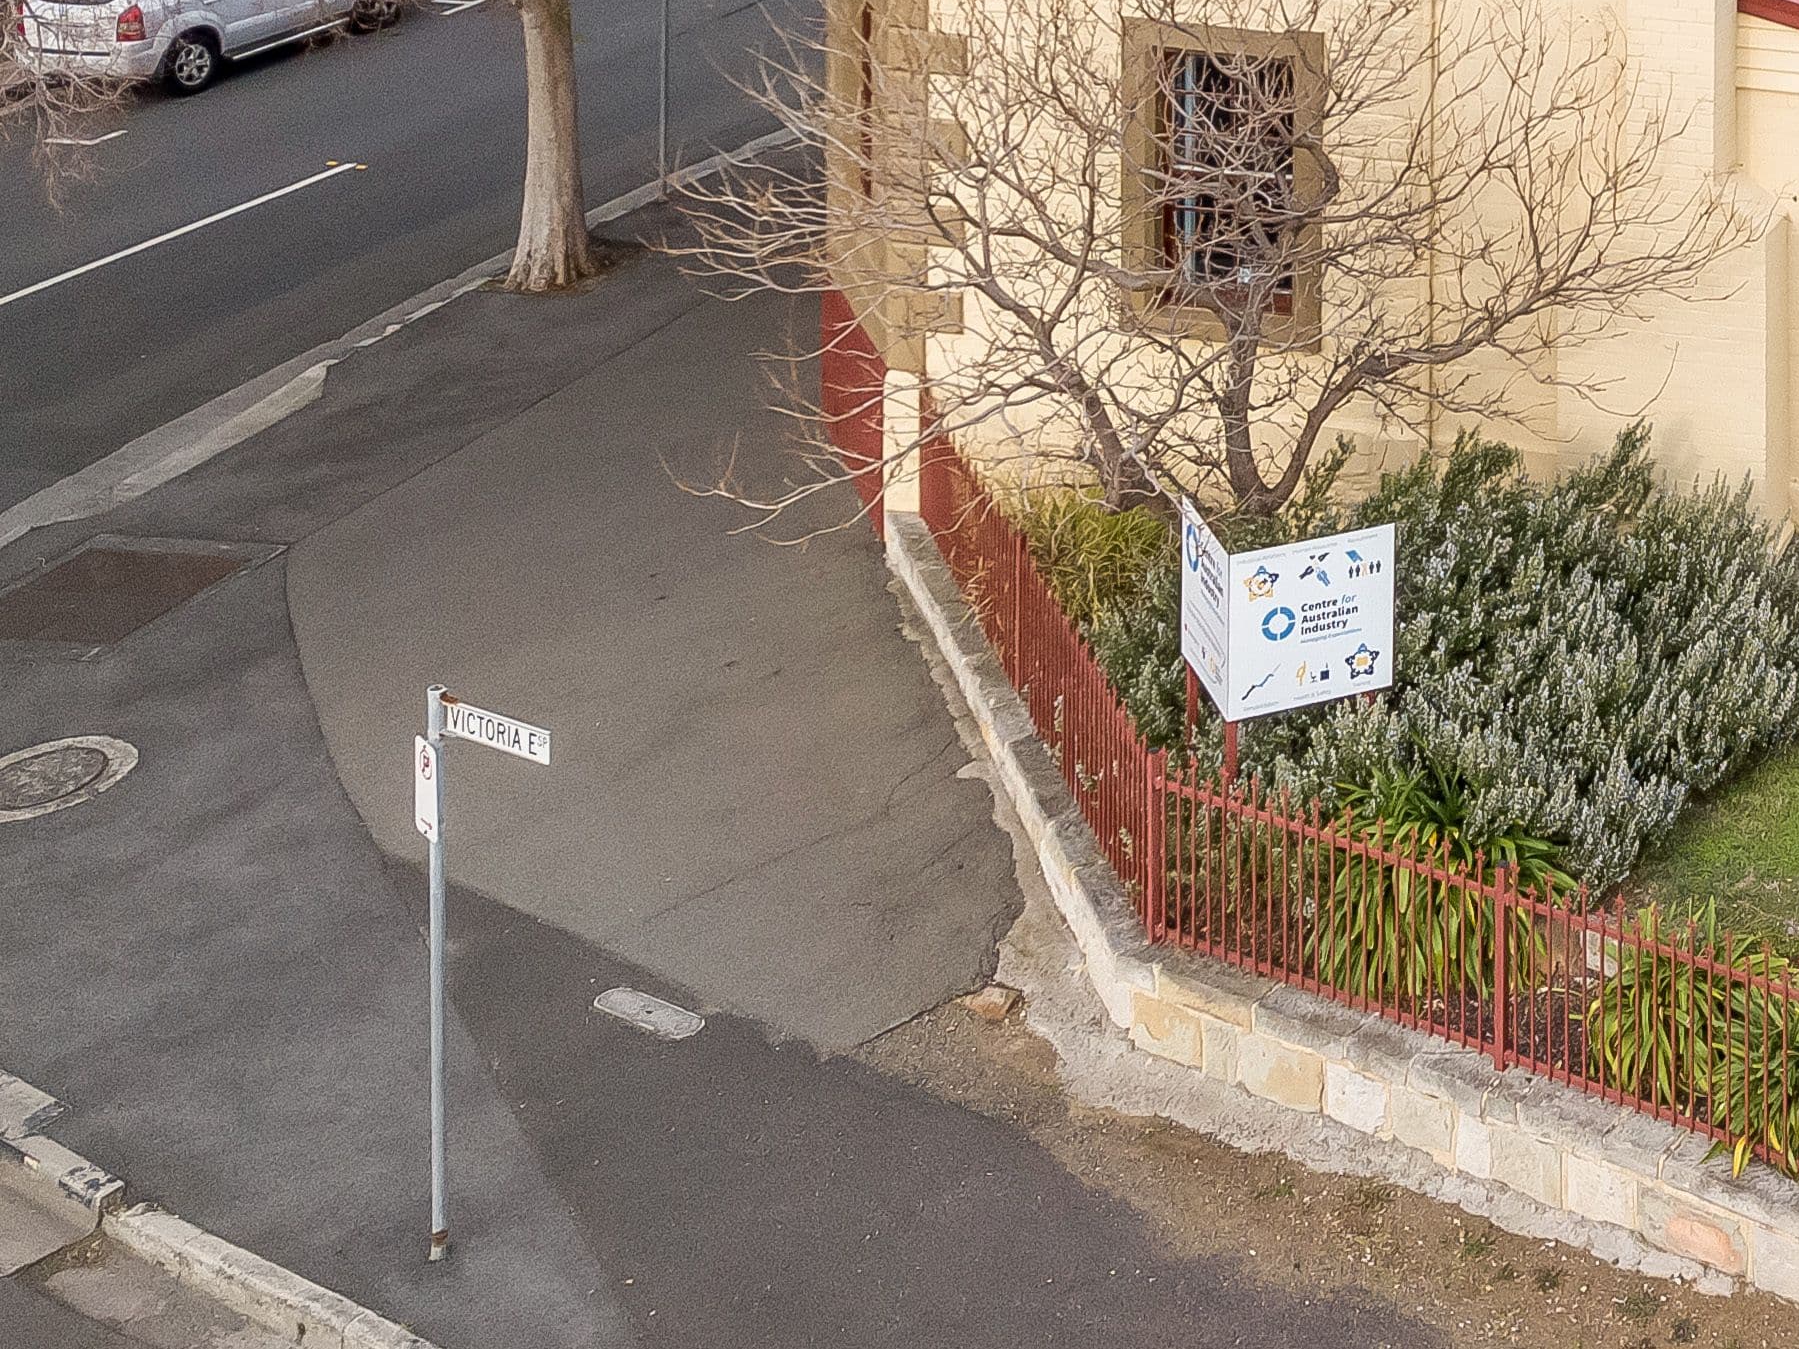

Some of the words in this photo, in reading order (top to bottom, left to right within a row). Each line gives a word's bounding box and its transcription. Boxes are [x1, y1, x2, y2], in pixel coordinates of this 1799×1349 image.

[1300, 598, 1338, 613] Centre
[1341, 593, 1358, 605] for
[1301, 605, 1359, 625] Australian
[1300, 618, 1349, 636] Industry
[451, 708, 522, 751] VICTORIA
